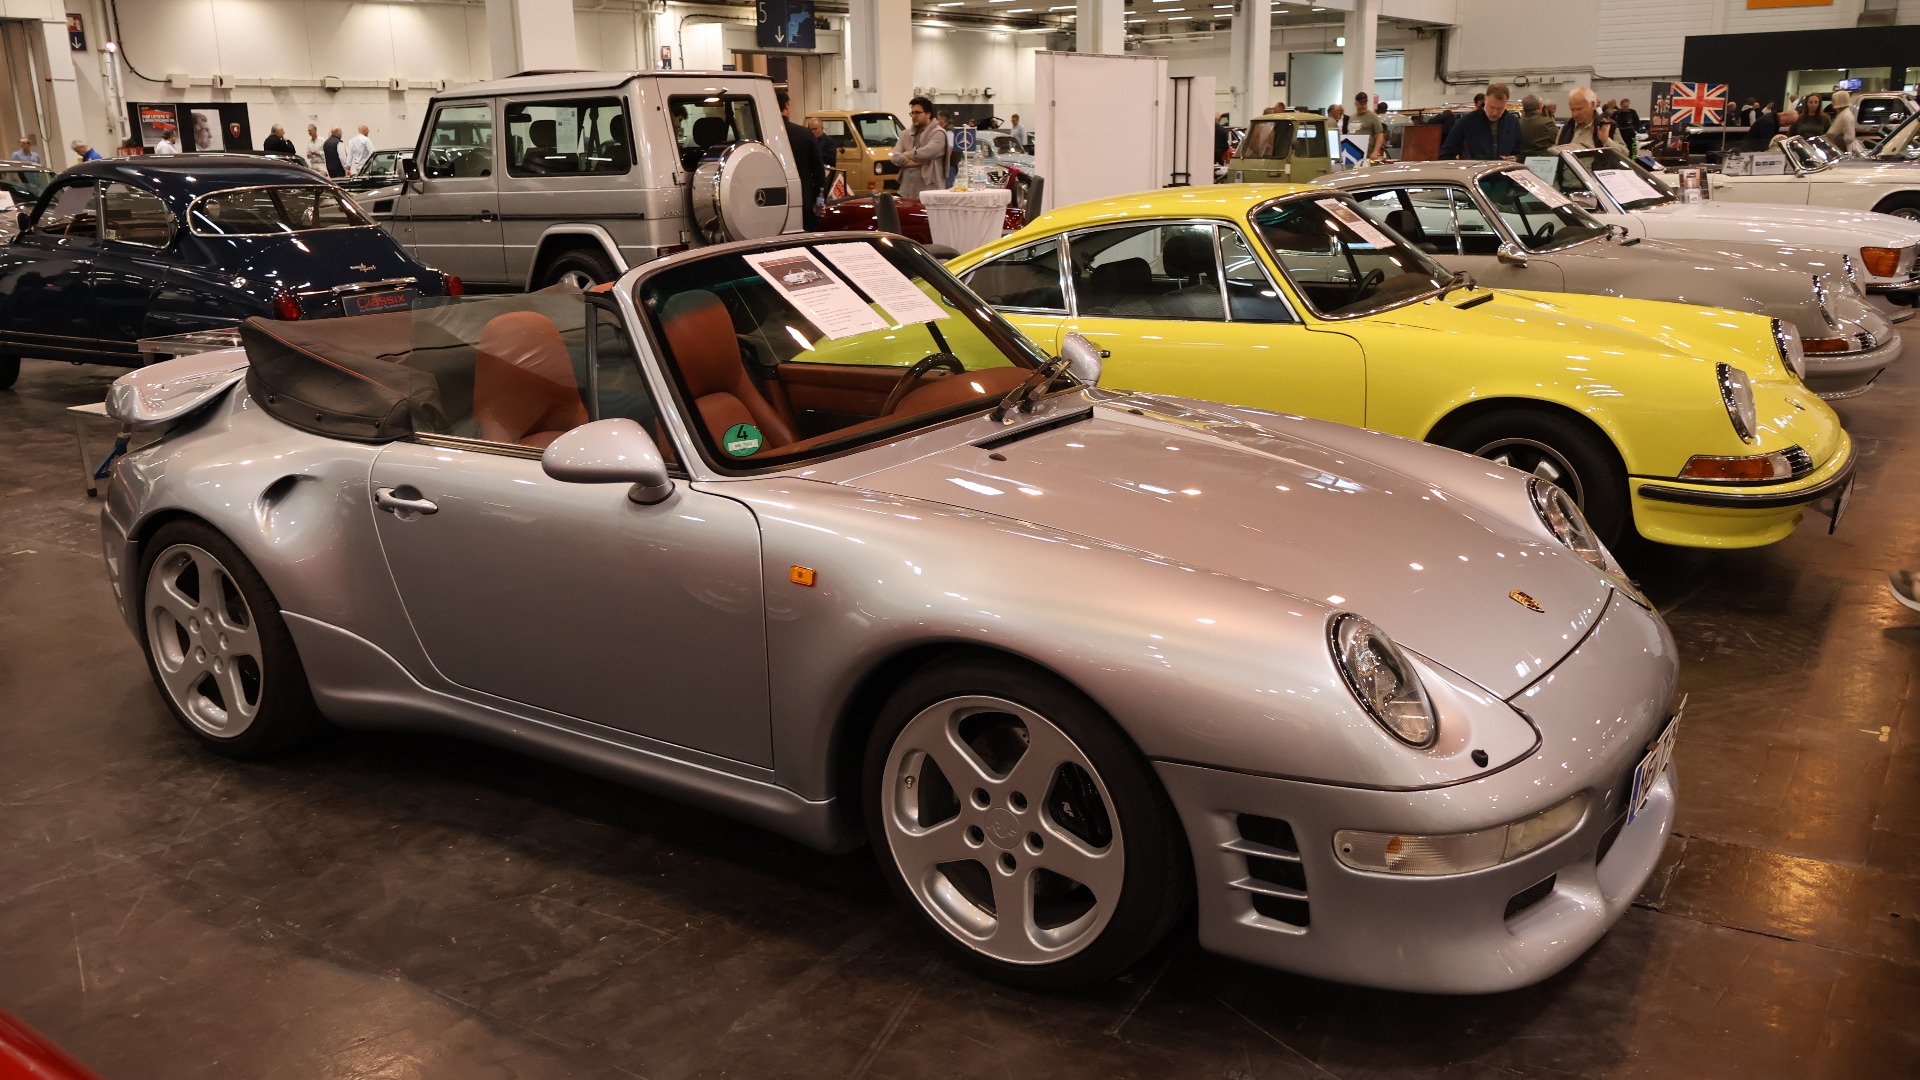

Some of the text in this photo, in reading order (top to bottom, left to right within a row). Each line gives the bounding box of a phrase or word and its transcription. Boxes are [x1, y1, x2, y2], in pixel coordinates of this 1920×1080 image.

[759, 1, 767, 23] 5
[356, 294, 404, 308] Classix
[737, 425, 748, 439] 4
